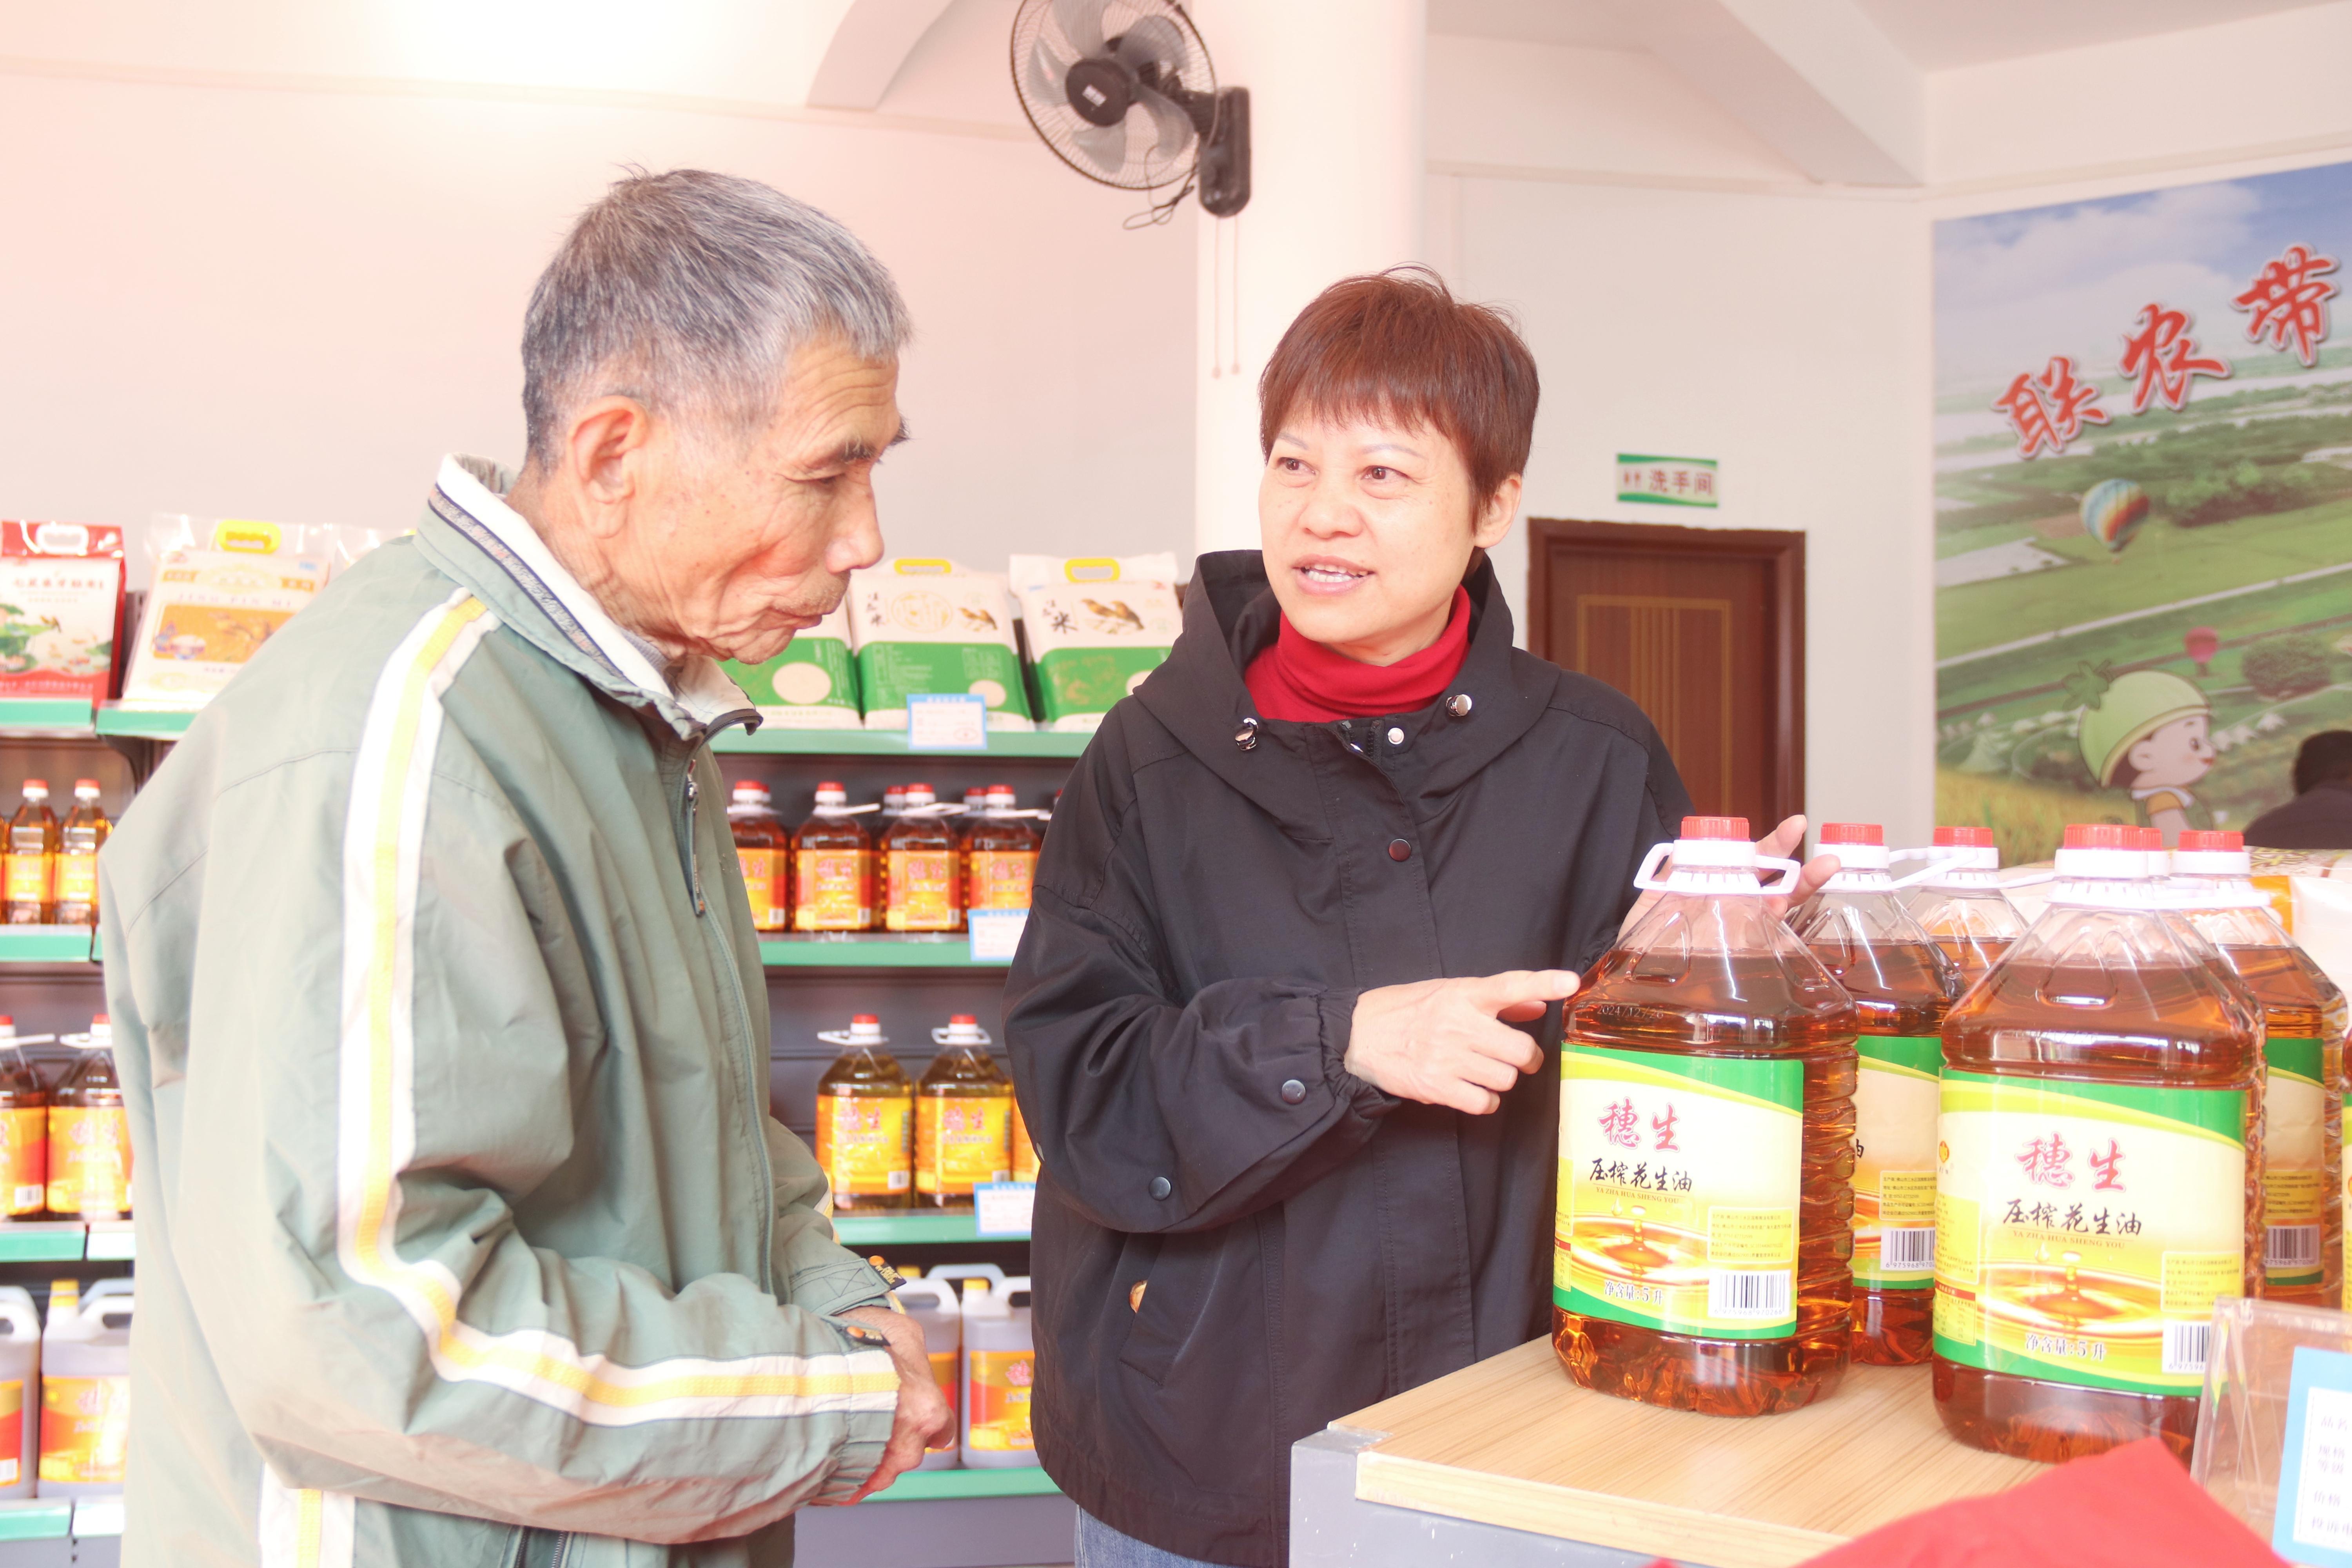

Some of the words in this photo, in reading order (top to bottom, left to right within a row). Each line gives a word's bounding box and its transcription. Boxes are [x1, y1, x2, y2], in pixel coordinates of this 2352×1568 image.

[1992, 242, 2340, 460] 联农带
[1649, 468, 1713, 495] 洗手间
[1599, 1096, 1680, 1152] 穗生
[1590, 1158, 1692, 1193] 压榨花生油
[2015, 1131, 2127, 1193] 穗生
[1637, 1192, 1662, 1202] SHENG
[2003, 1199, 2143, 1236] 压榨花生油
[2026, 1232, 2045, 1240] ZHA
[2047, 1234, 2068, 1243] HUA
[2070, 1236, 2103, 1247] SHENG
[2105, 1241, 2125, 1249] YOU
